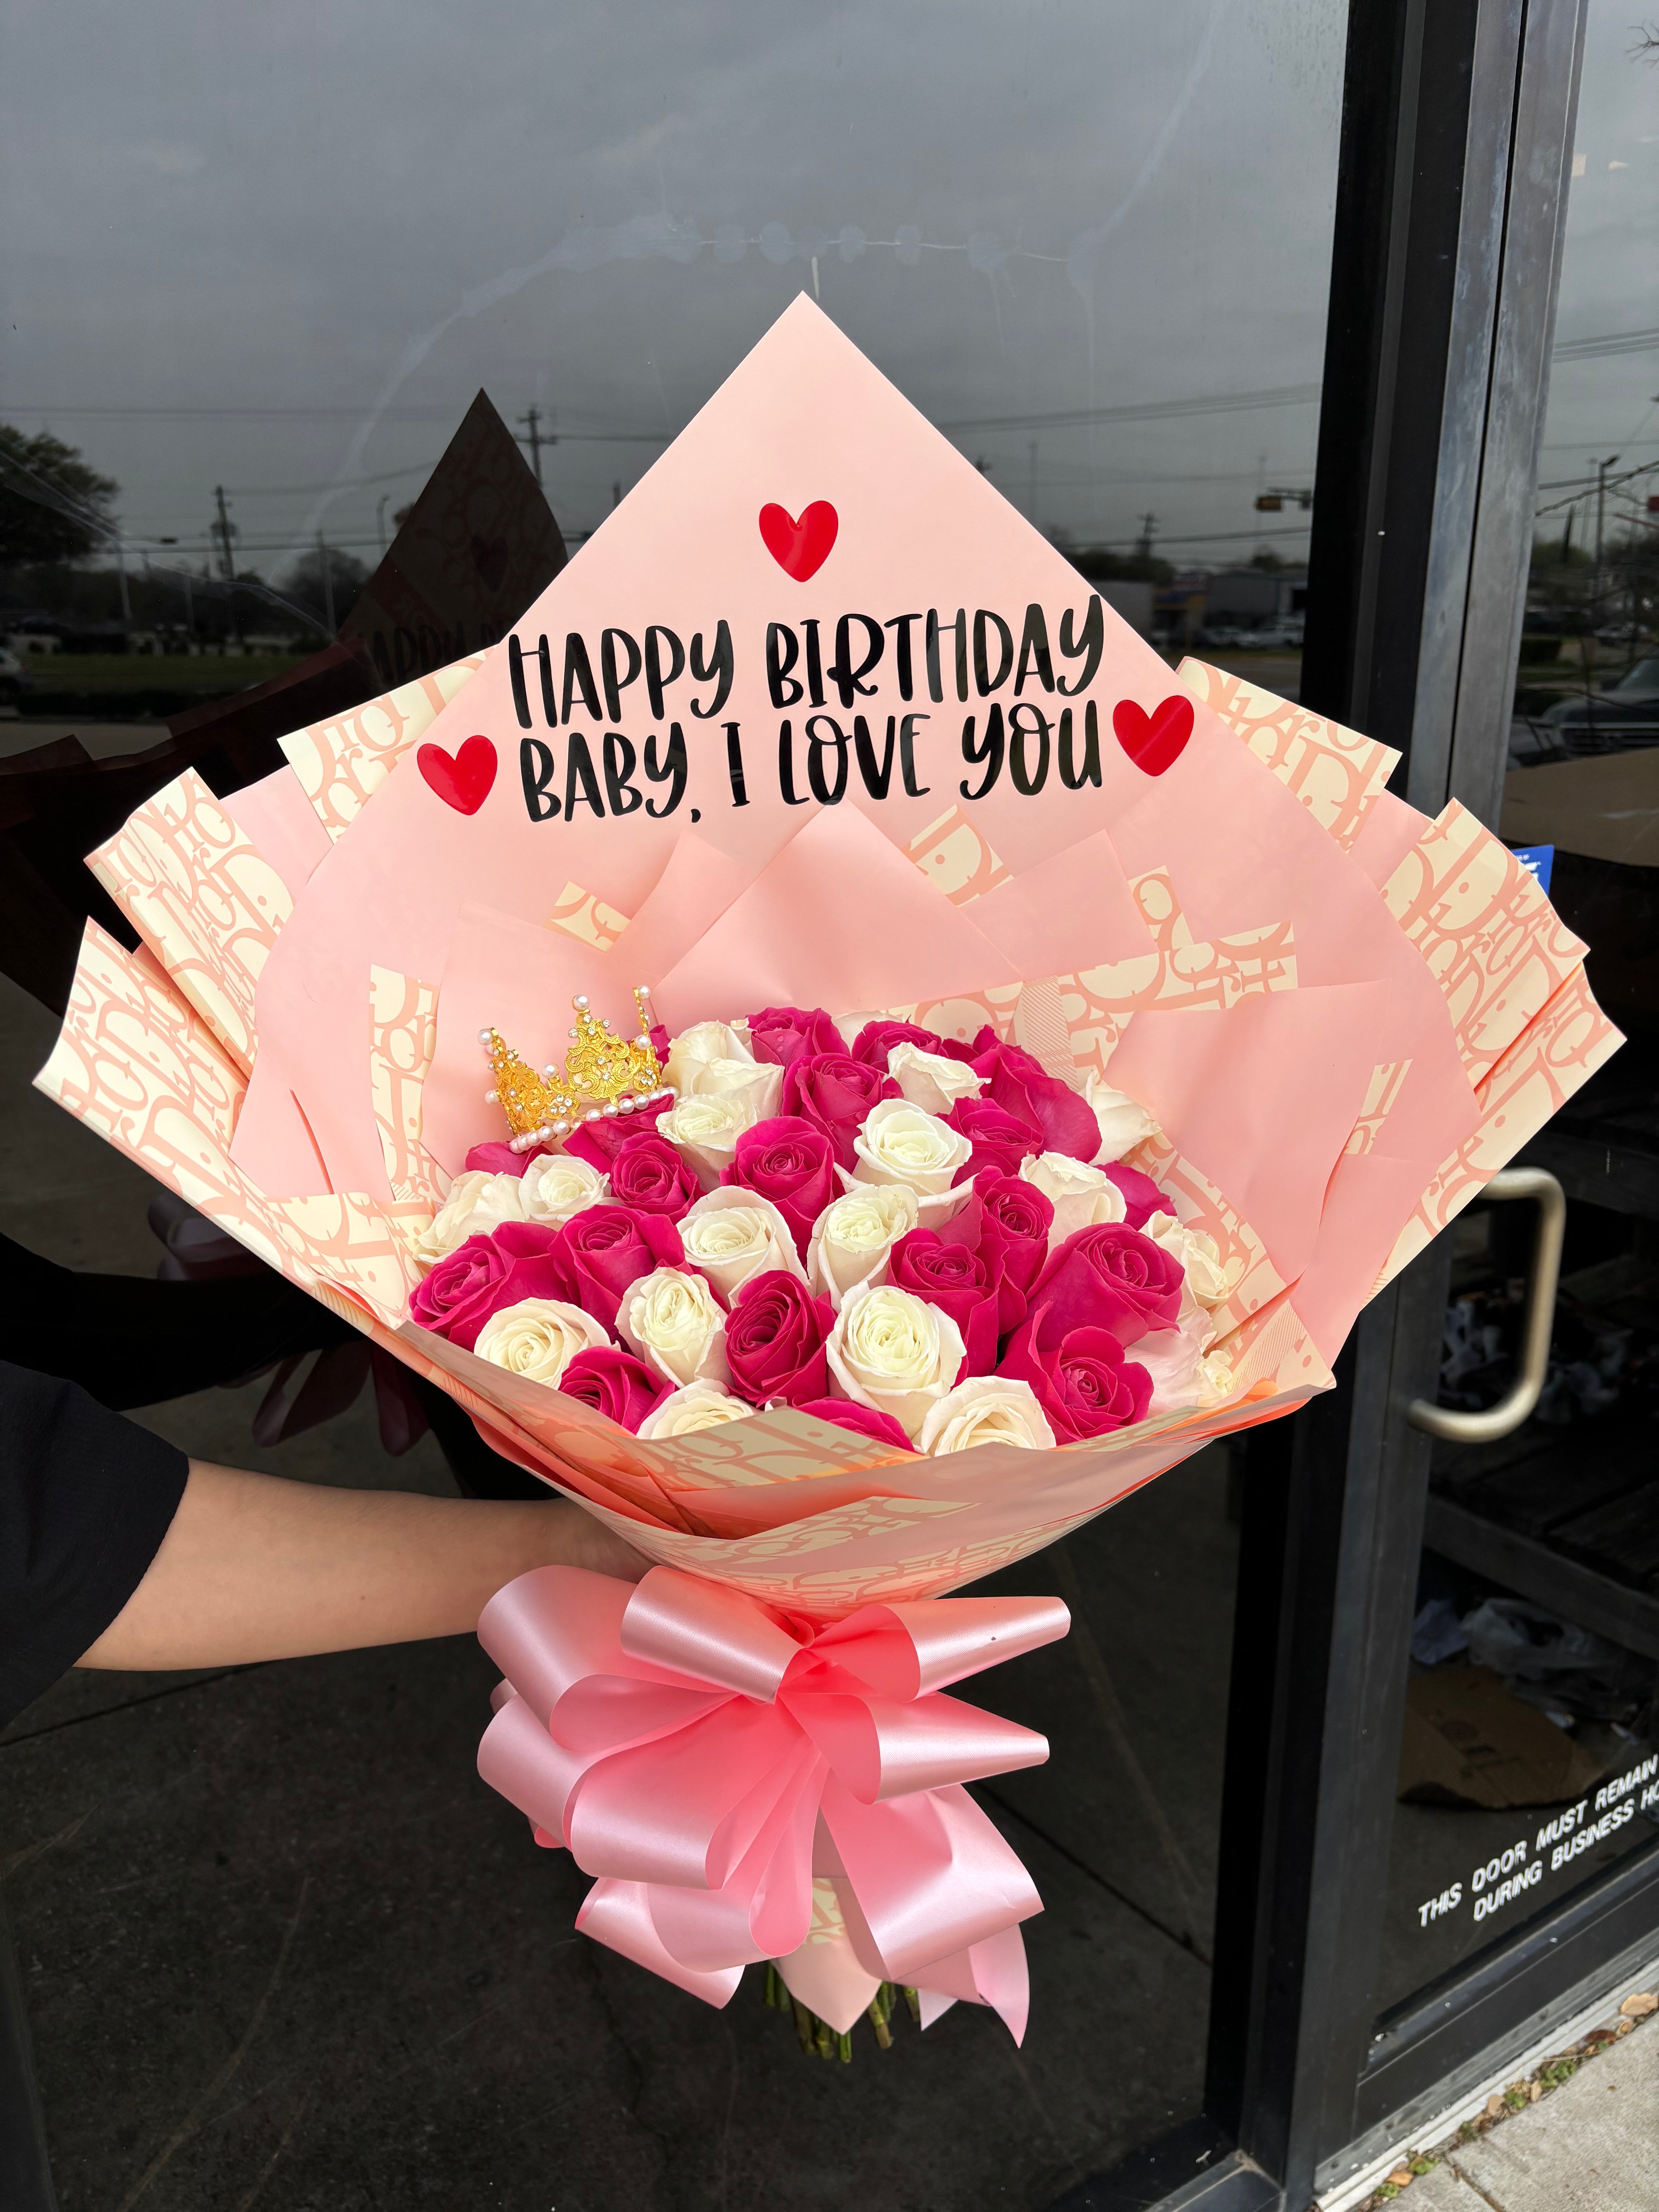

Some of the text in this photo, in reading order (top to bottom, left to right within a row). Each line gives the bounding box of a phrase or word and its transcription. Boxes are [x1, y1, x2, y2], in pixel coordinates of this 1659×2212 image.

[508, 594, 1104, 729] HAPPY BIRTHDAY
[519, 721, 701, 823] BABY,
[720, 721, 750, 807] I
[778, 713, 931, 806] LOVE
[959, 699, 1103, 800] YOU
[1418, 1753, 1659, 1927] THIS DOOR MUST REMAIN
[1473, 1860, 1543, 1922] DURING
[1551, 1798, 1635, 1871] BUSINESS
